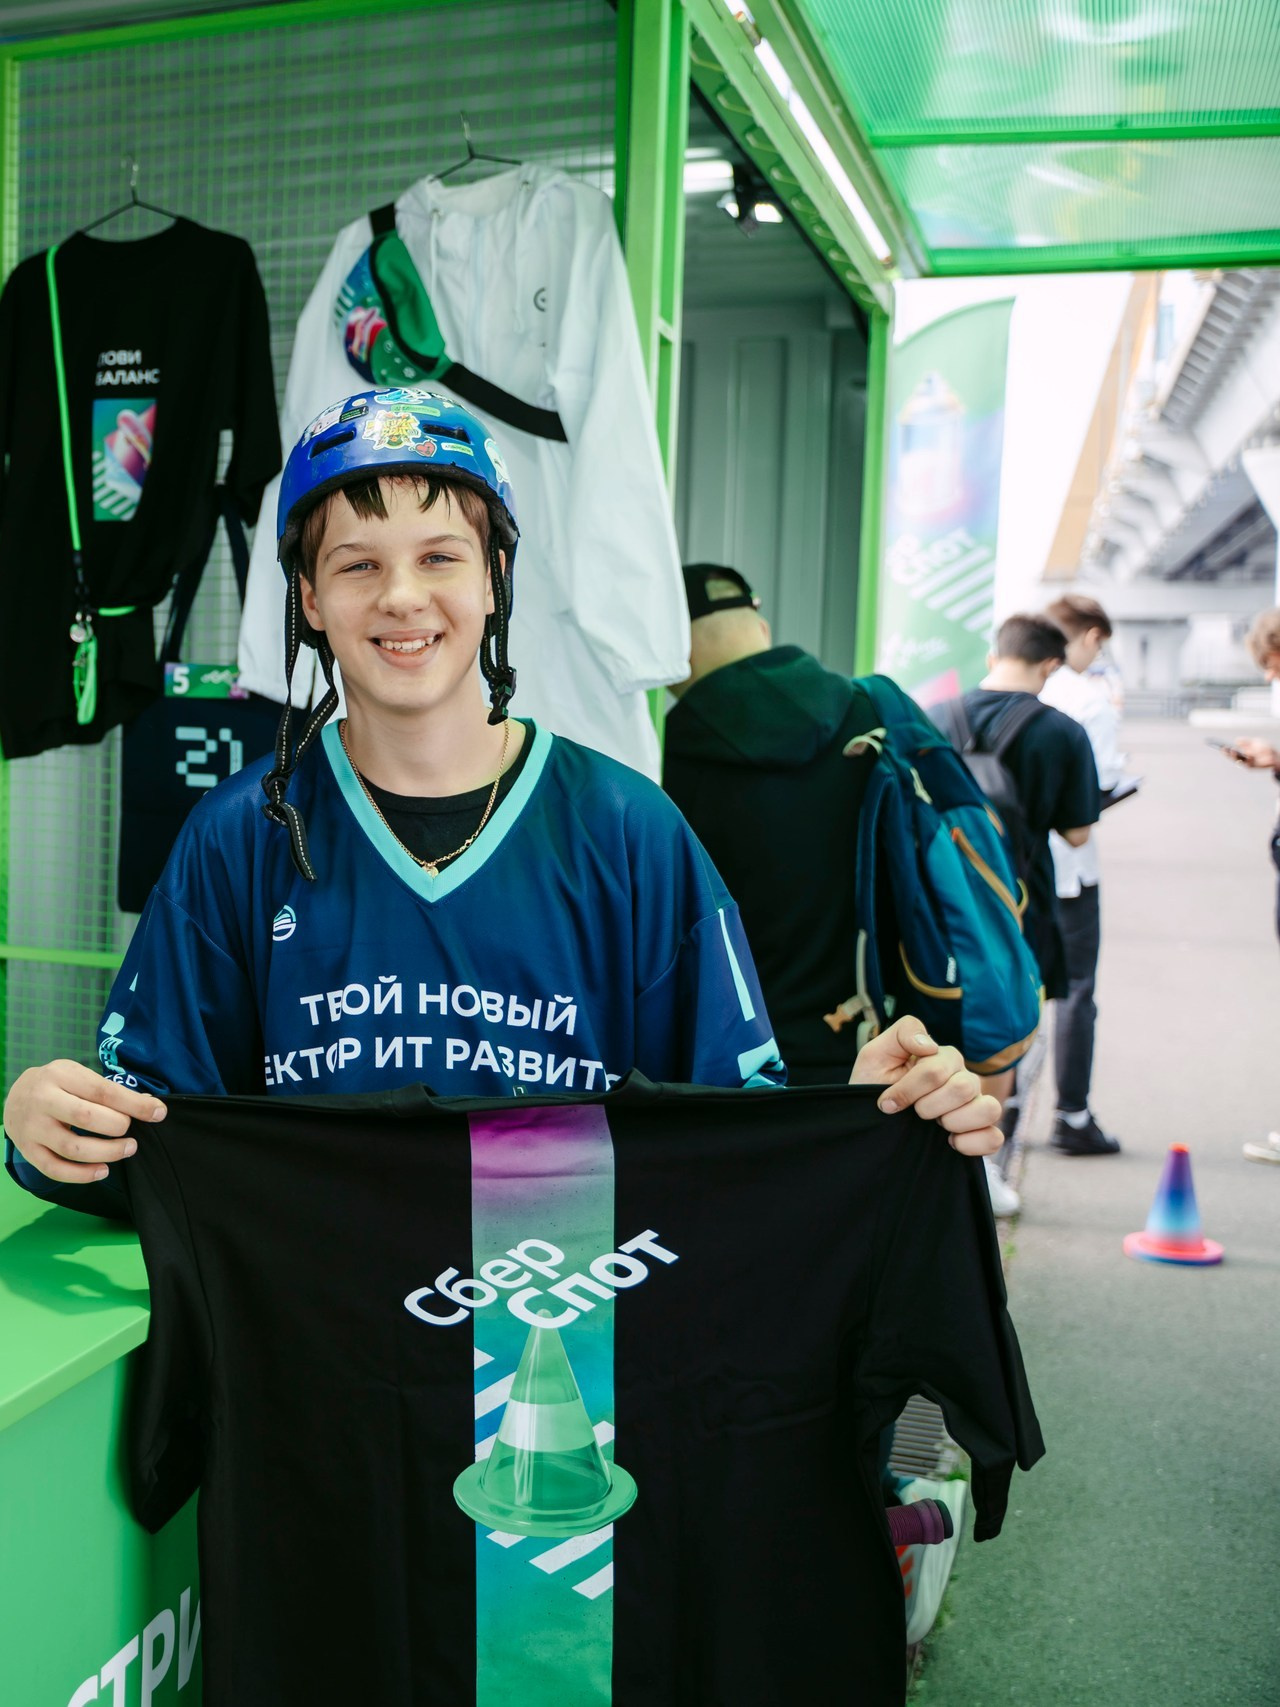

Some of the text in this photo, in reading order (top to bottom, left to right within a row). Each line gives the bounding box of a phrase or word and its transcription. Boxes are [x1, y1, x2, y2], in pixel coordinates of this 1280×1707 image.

[172, 666, 190, 694] 5
[300, 975, 578, 1036] ТВОЙ НОВЫЙ
[375, 1036, 433, 1069] ИТ
[404, 1238, 565, 1326] Сбер
[507, 1229, 680, 1329] Спот
